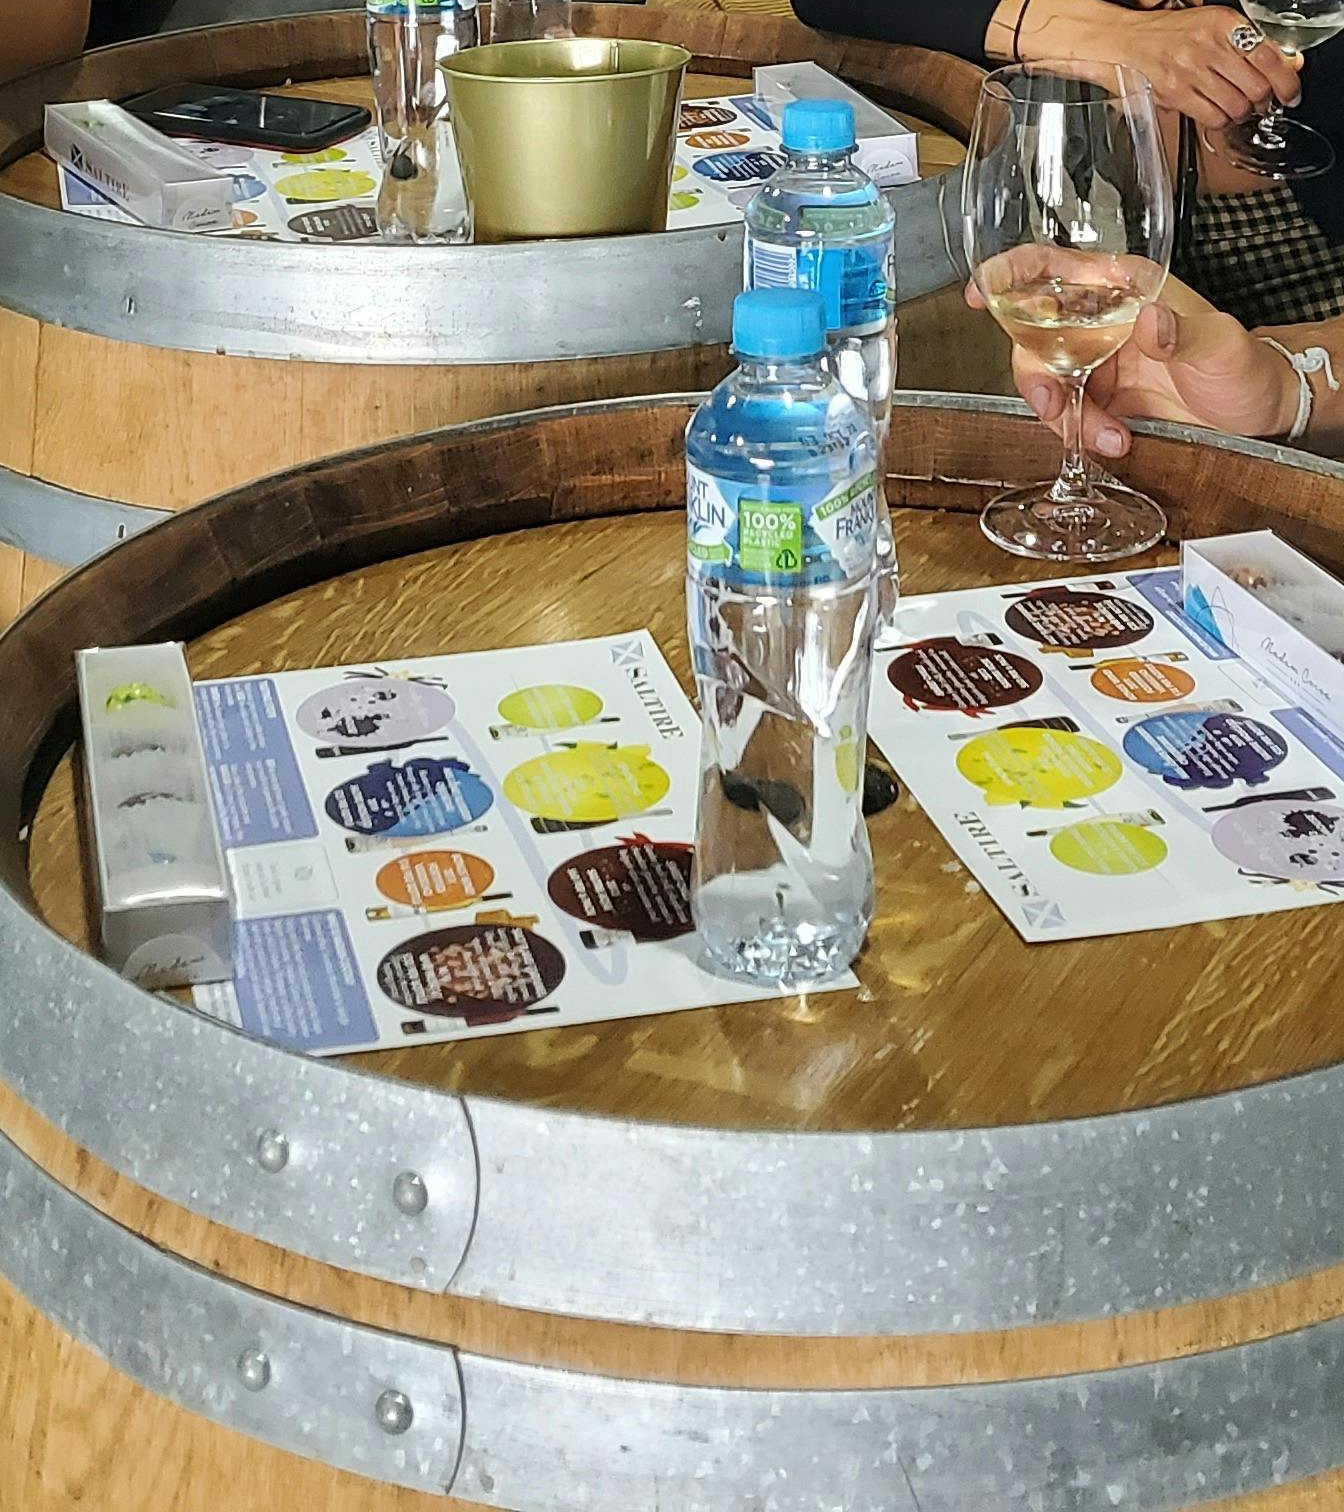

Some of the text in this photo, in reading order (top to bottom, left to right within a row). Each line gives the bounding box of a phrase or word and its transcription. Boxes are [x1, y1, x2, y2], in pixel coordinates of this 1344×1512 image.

[743, 511, 796, 530] 100%
[625, 667, 685, 740] SALTIRE
[953, 811, 1041, 897] SALTIRE
